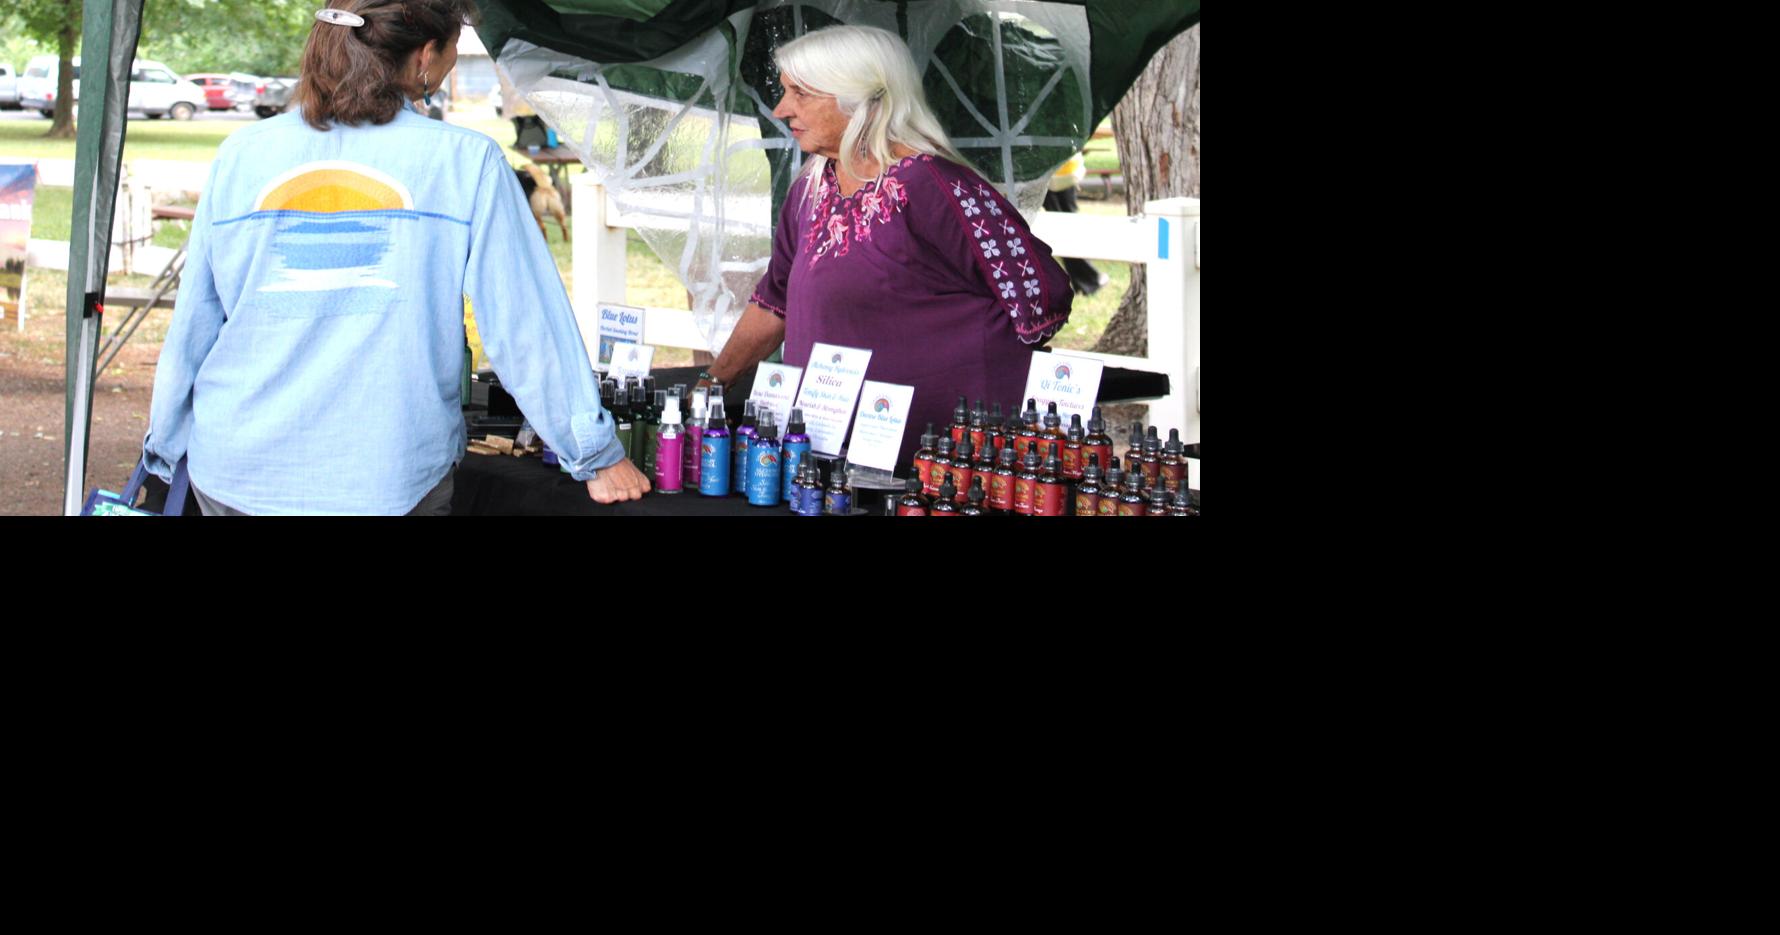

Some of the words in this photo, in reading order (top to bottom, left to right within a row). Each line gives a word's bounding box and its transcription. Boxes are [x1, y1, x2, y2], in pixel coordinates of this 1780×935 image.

[601, 309, 618, 321] Blue
[619, 312, 638, 325] Lotus
[816, 375, 843, 387] Silica
[1040, 379, 1051, 390] Qi
